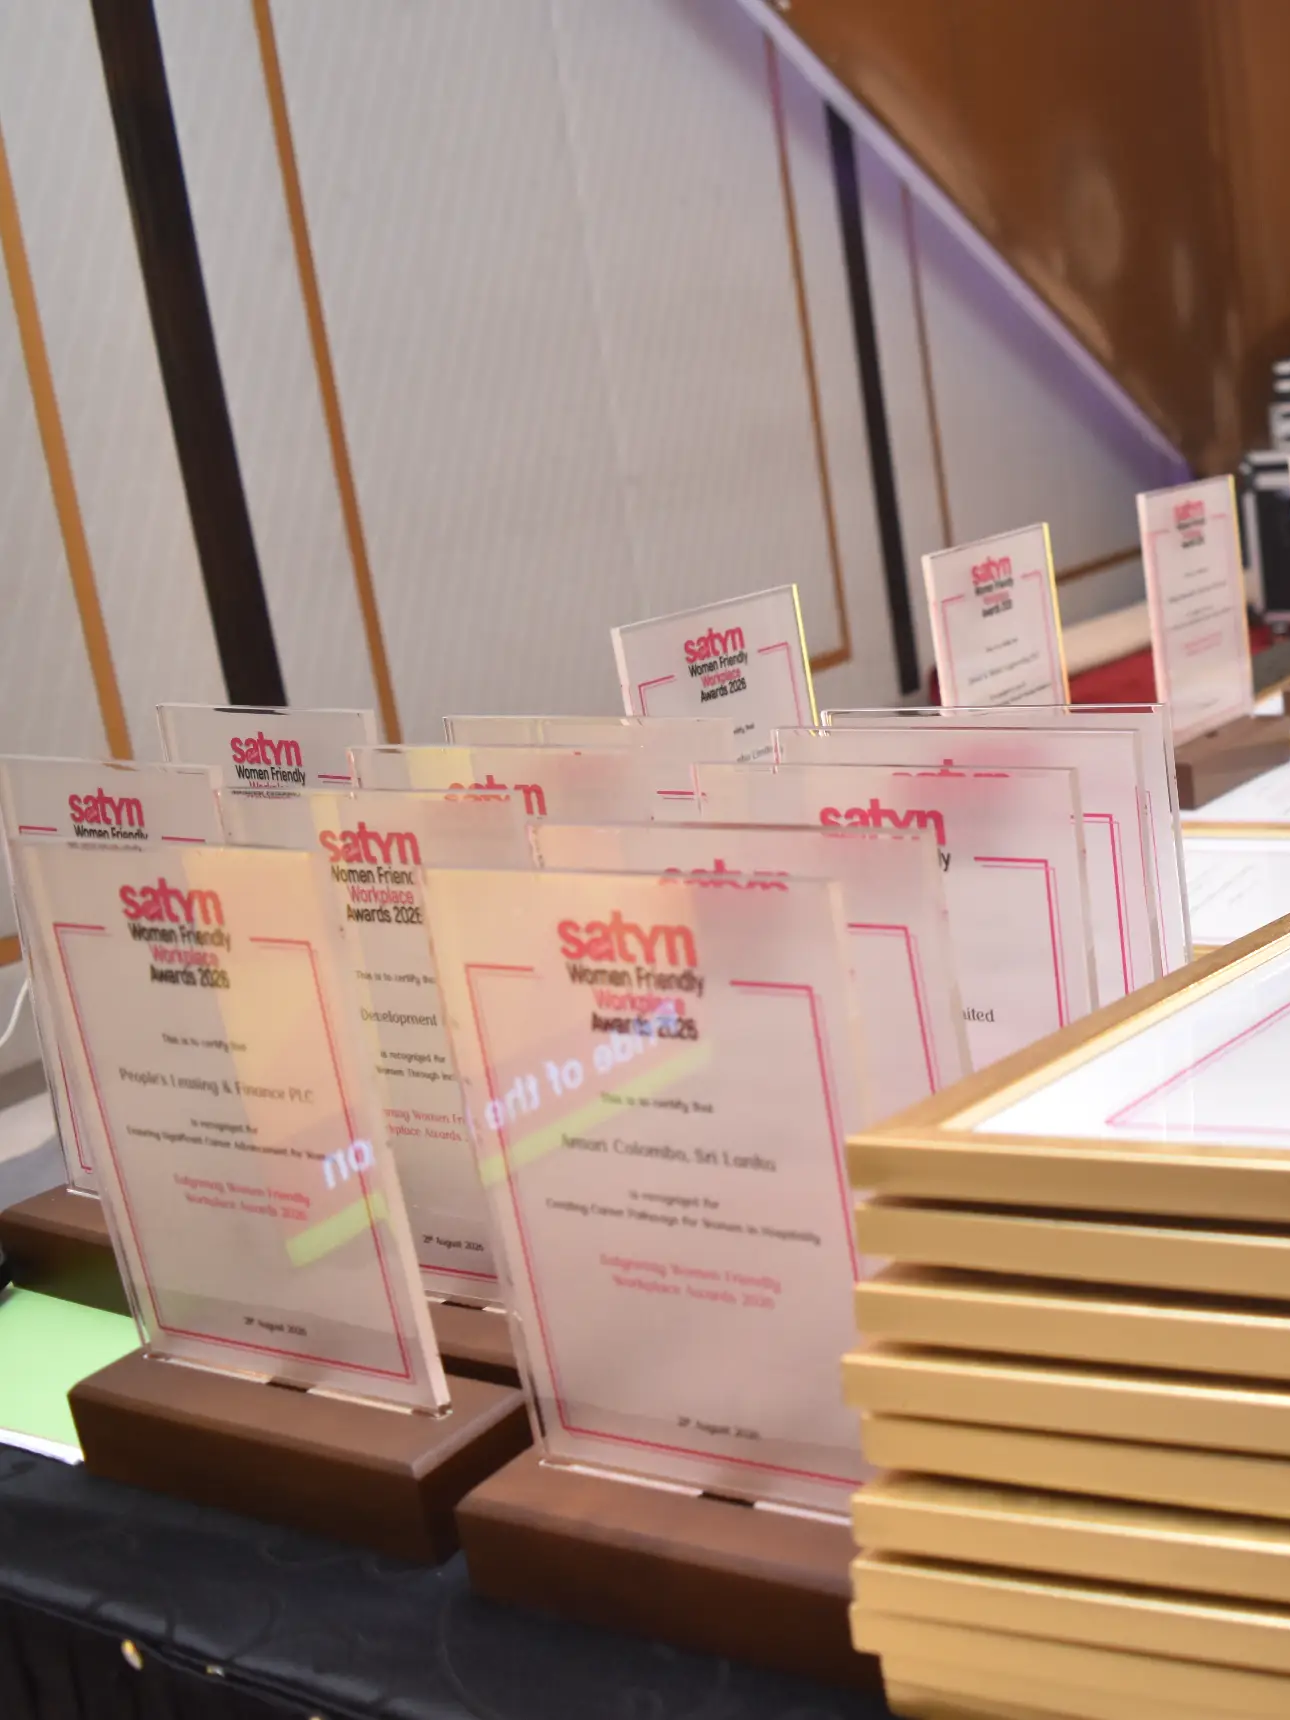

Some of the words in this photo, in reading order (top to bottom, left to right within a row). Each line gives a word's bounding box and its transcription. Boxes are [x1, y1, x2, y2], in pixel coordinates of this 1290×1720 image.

[684, 626, 746, 664] satyn
[688, 660, 718, 678] Women
[718, 650, 748, 667] Friendly
[701, 684, 728, 703] Awards
[230, 731, 303, 767] satyn
[235, 764, 270, 781] Women
[270, 766, 306, 787] Friendly
[68, 786, 144, 828] satyn
[73, 824, 109, 840] Women
[318, 821, 422, 866] satyn
[119, 876, 225, 926] satyn
[346, 903, 391, 923] Awards
[127, 922, 178, 944] Women
[178, 925, 232, 953] Friendly
[557, 909, 699, 968] satyn
[149, 963, 197, 987] Awards
[565, 960, 632, 988] Women
[633, 966, 705, 999] Friendly
[361, 1006, 438, 1027] Development
